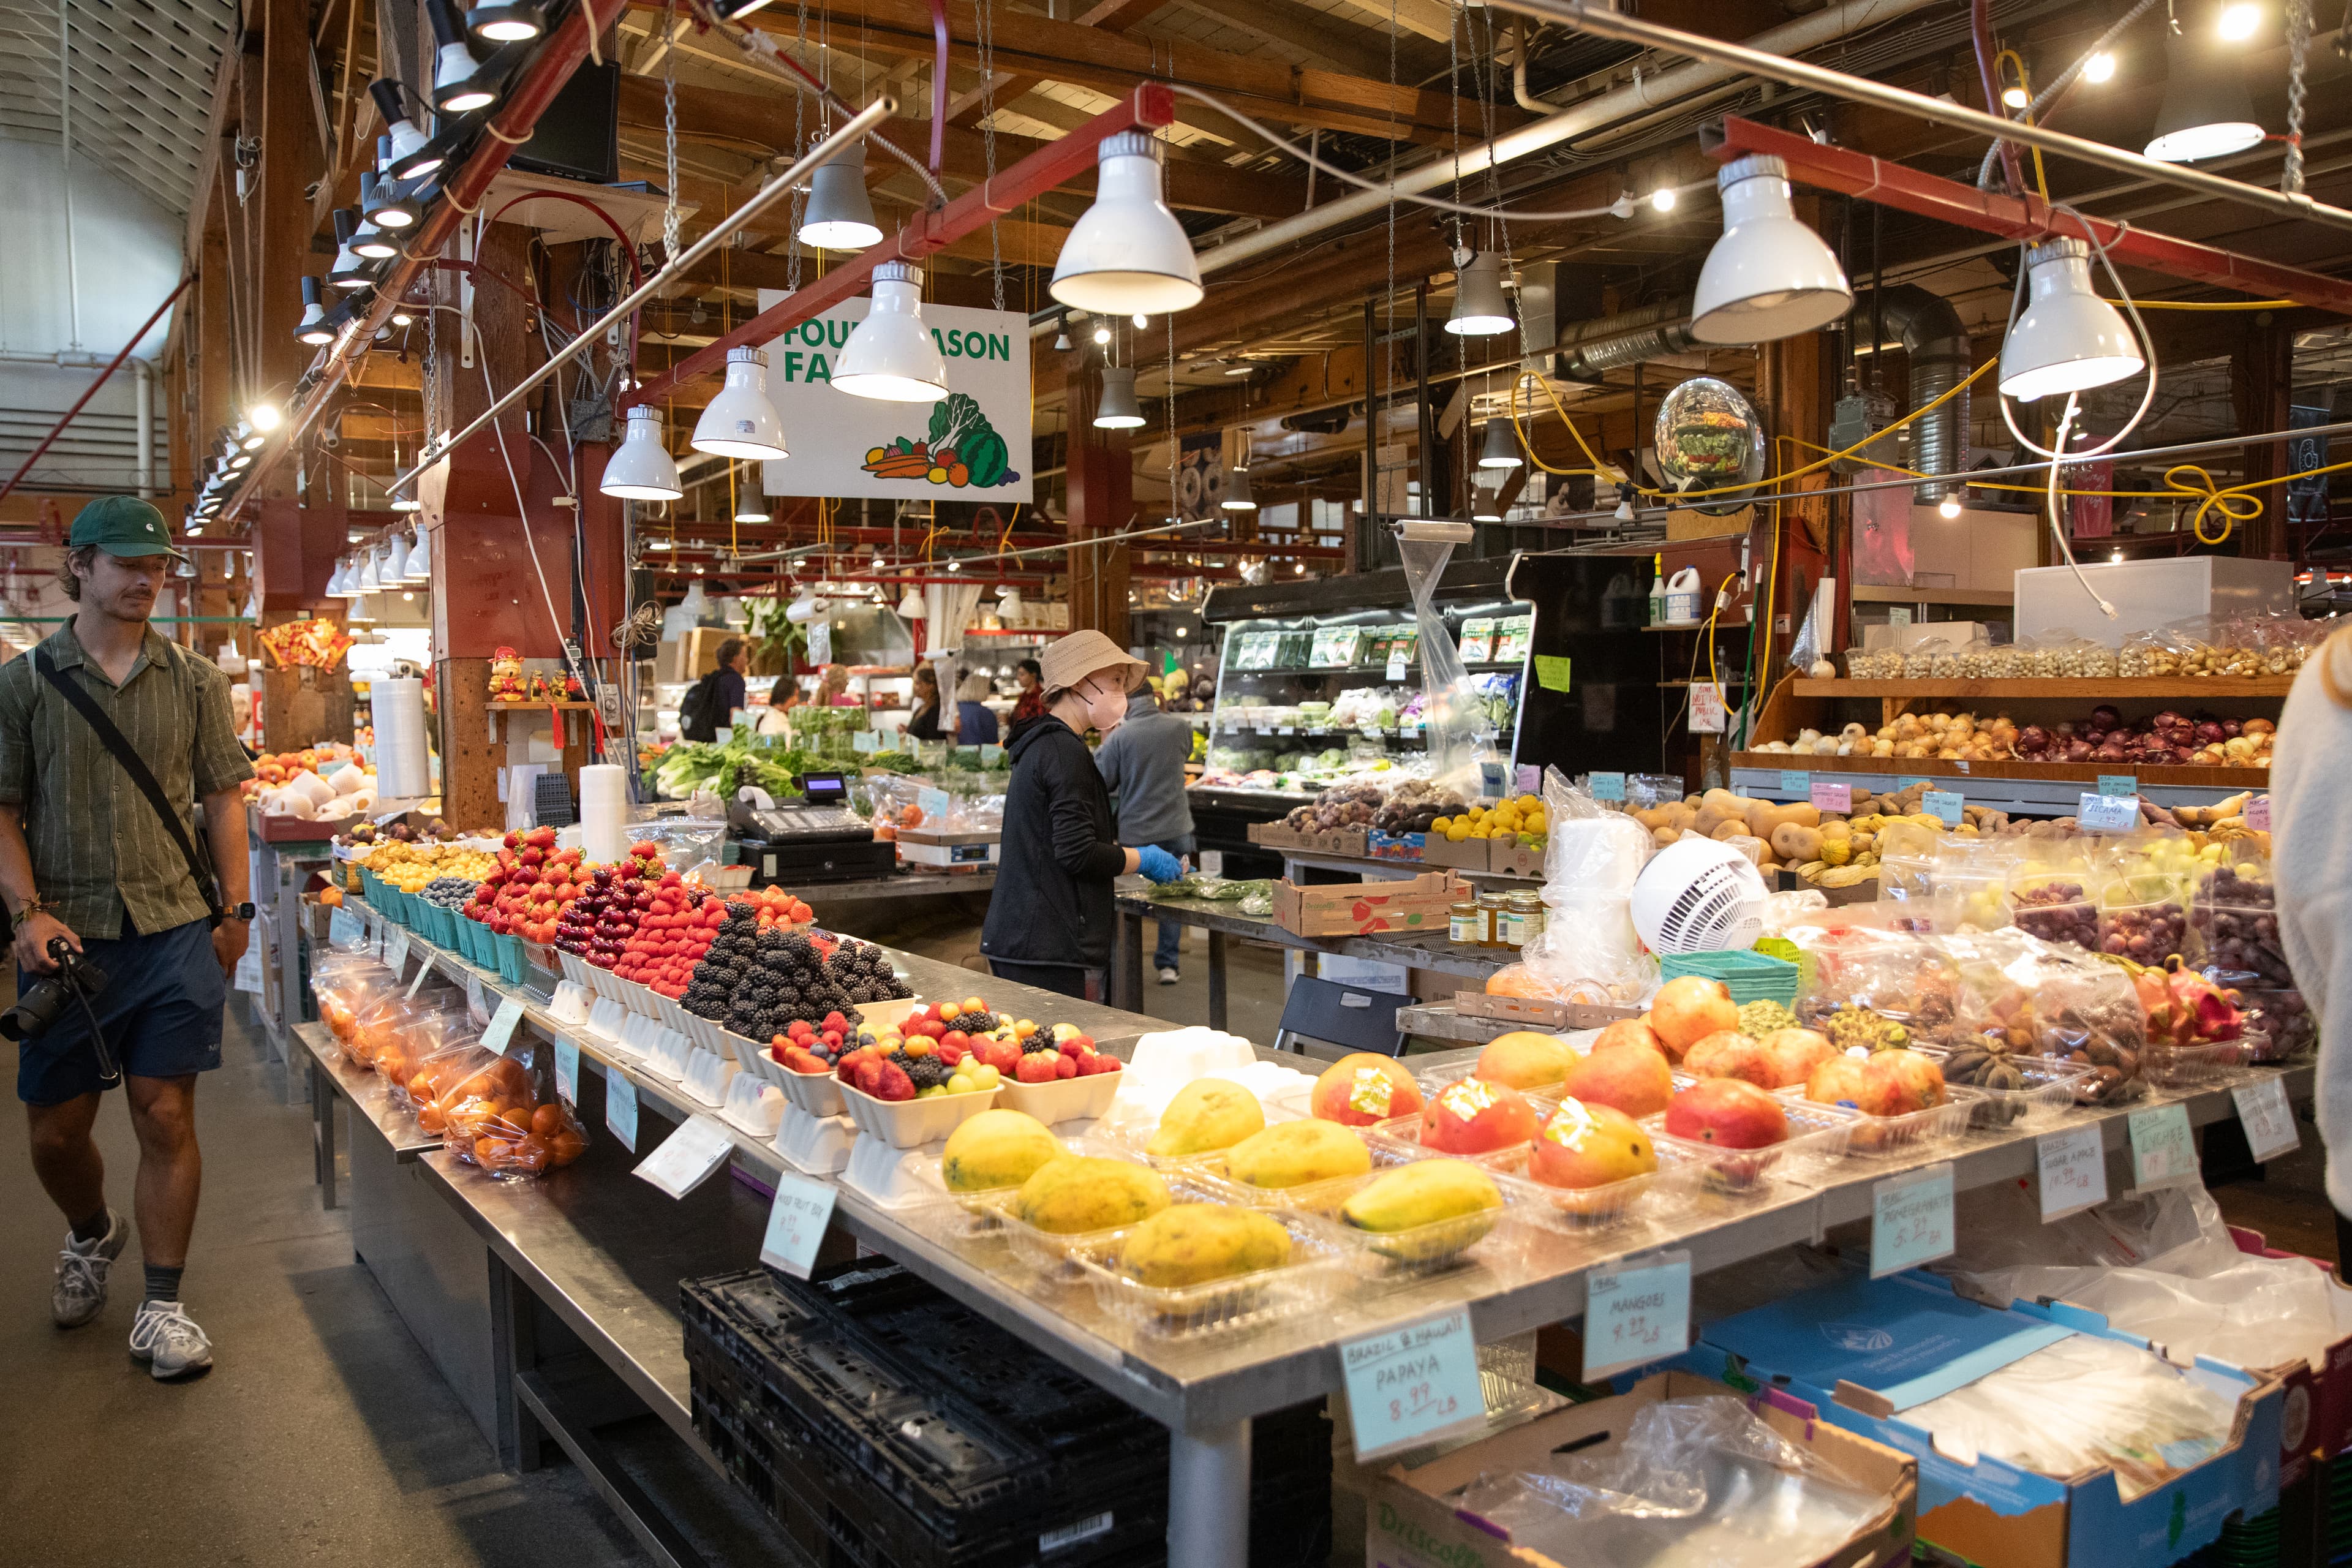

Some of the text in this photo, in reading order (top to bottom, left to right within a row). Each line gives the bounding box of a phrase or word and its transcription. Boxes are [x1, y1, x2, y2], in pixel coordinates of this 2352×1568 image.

[784, 318, 1009, 361] FOU ASON
[785, 351, 839, 384] FA
[1692, 694, 1705, 704] NOT
[1695, 706, 1718, 716] PUBLIC
[2088, 805, 2122, 815] JICAMA
[1609, 1292, 1665, 1315] MANGOES
[1348, 1339, 1396, 1365] BRAZIL
[1415, 1314, 1463, 1343] HAWAII
[1376, 1354, 1441, 1392] PAPAYA
[1438, 1396, 1458, 1415] LB
